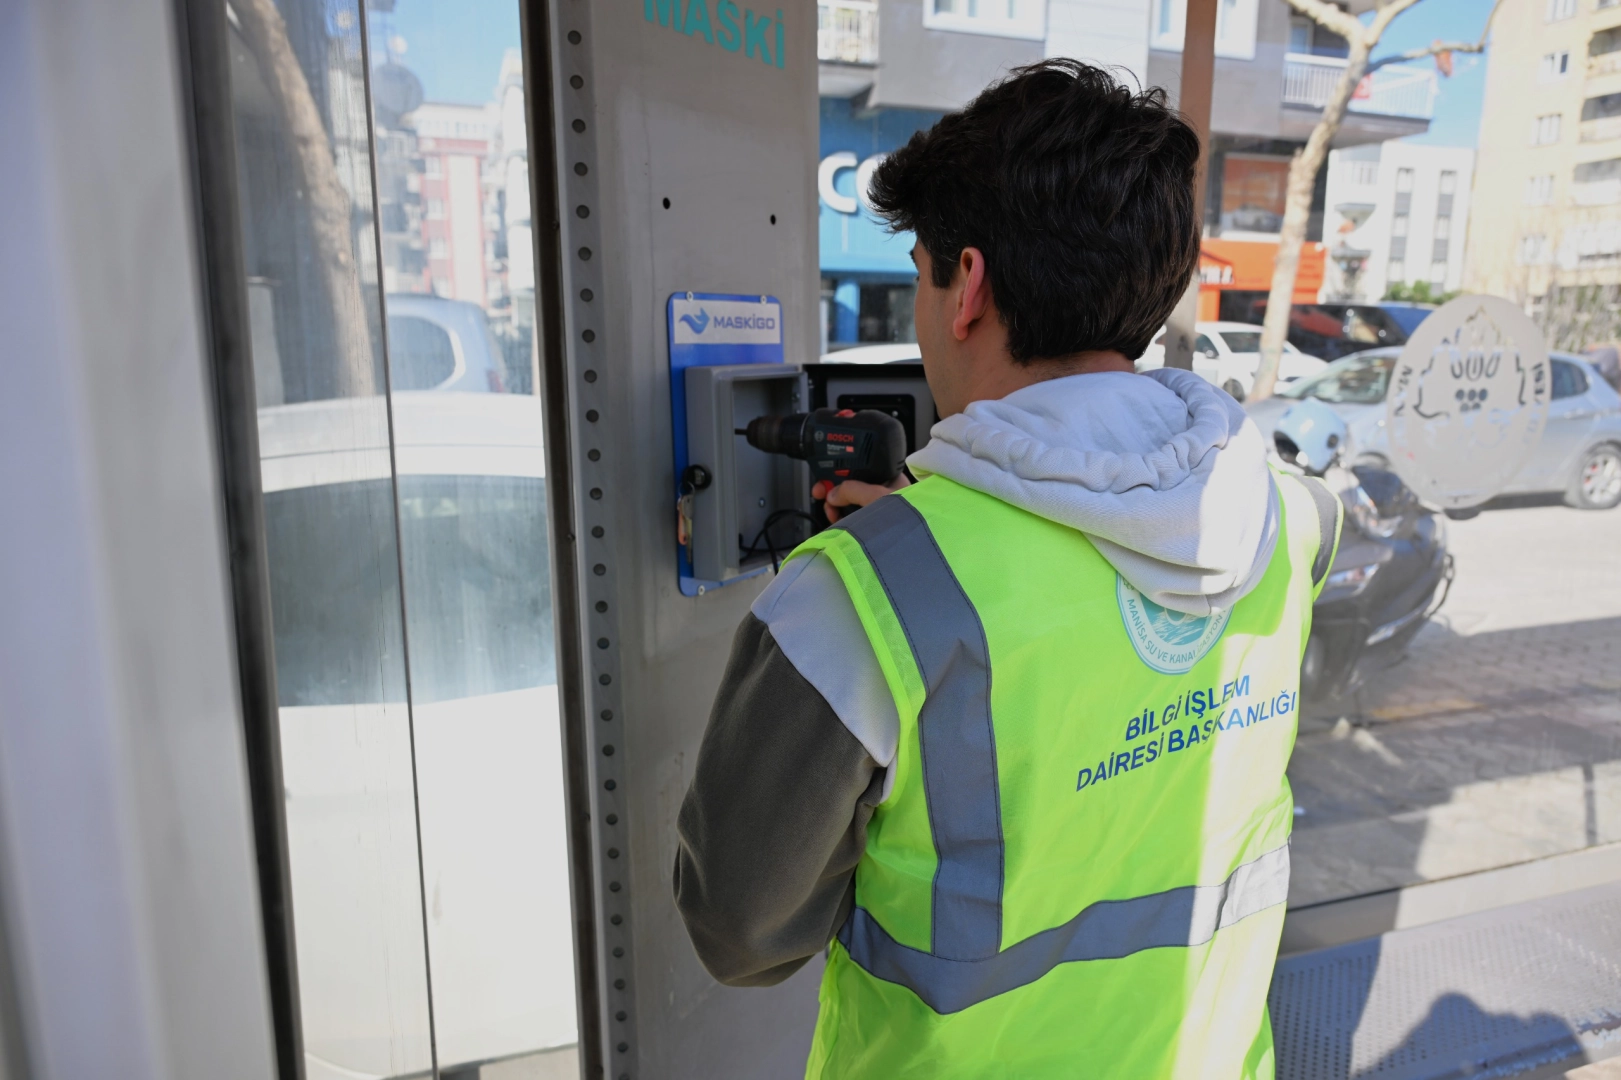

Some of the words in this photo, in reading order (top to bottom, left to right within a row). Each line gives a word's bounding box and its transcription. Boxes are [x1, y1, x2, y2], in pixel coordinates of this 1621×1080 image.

[714, 313, 776, 330] MASKİGO
[827, 433, 854, 443] BOSCH
[1127, 598, 1147, 643] MANİSA
[1145, 640, 1157, 656] SU
[1157, 649, 1169, 662] VE
[1125, 694, 1183, 741] BİLGİ
[1184, 674, 1250, 719] İŞLEM
[1076, 731, 1165, 792] DAİRESİ
[1167, 689, 1297, 754] BAŞKANLIĞI
